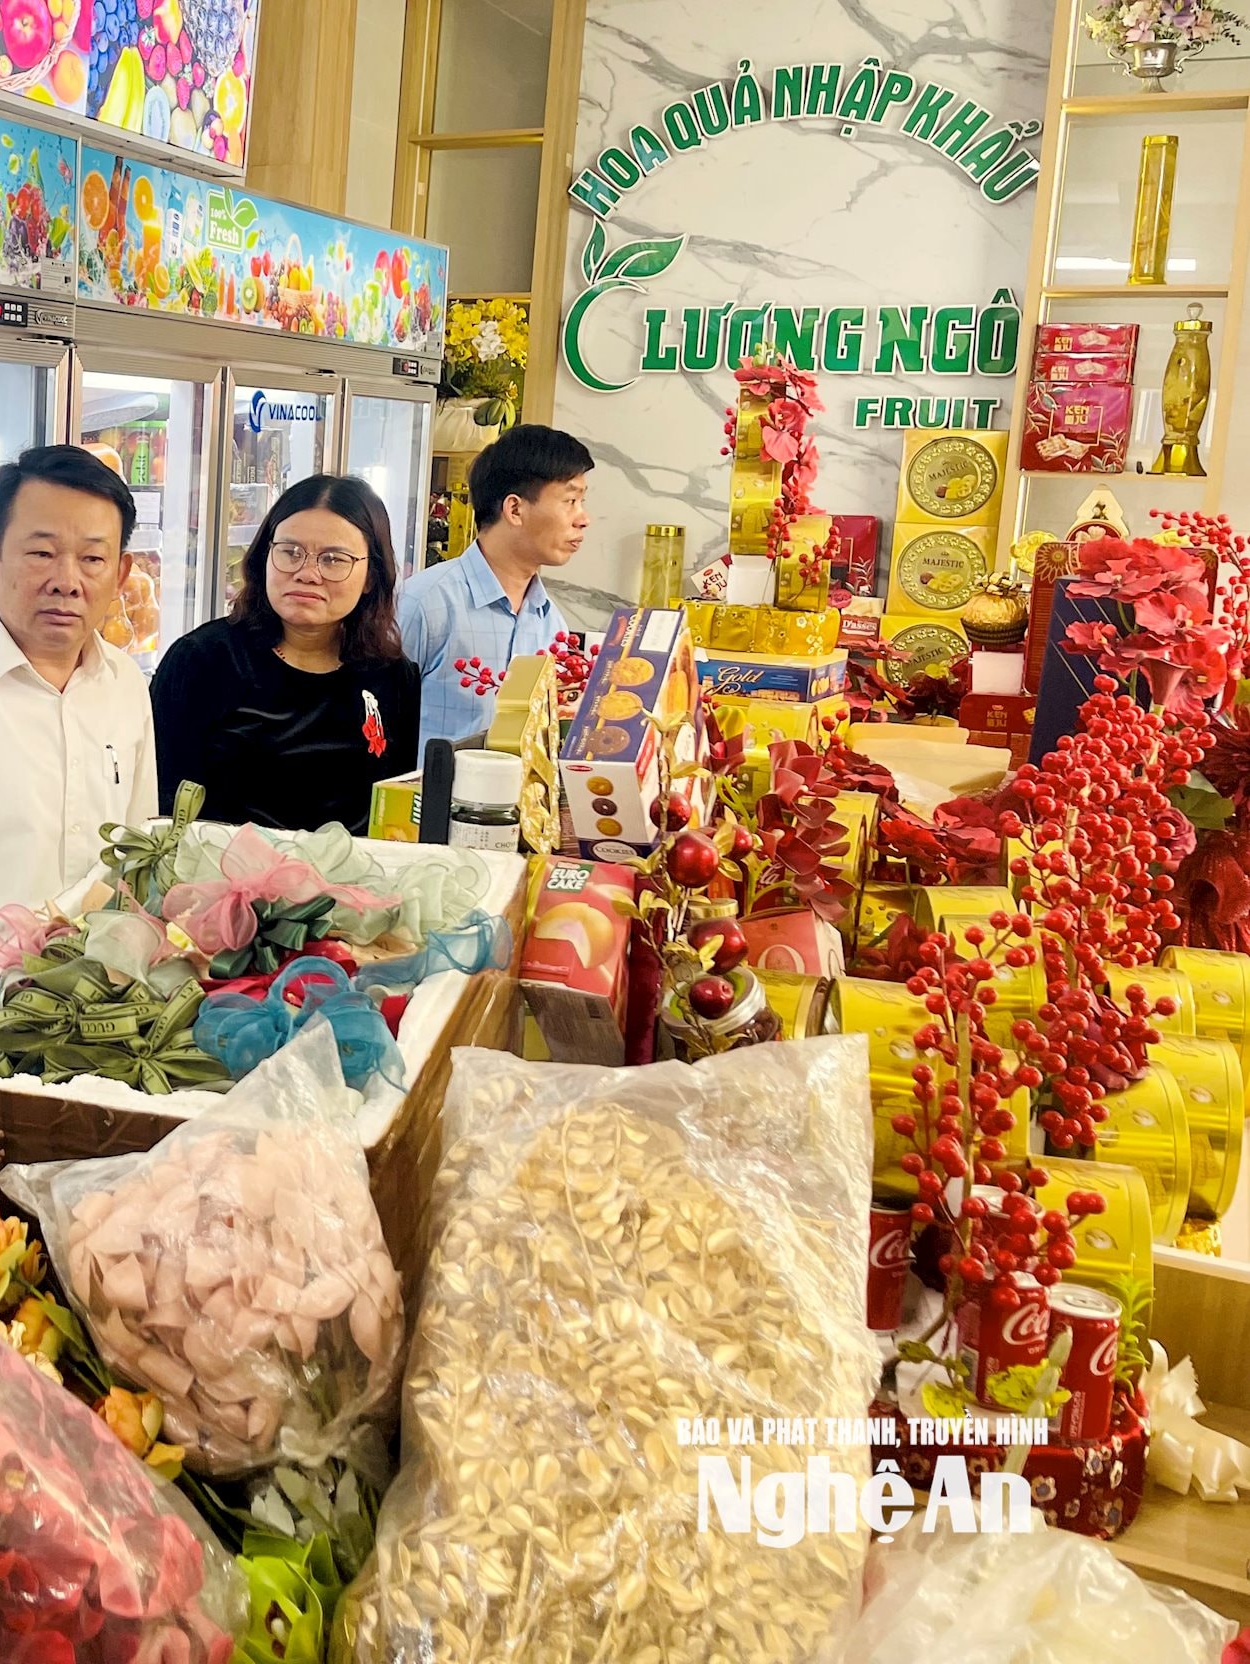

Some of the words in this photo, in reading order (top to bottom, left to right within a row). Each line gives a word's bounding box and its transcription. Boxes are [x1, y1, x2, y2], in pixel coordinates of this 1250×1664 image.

[568, 124, 671, 221] HOA
[662, 57, 765, 153] QUẢ
[770, 55, 916, 139] NHẬP
[900, 80, 1043, 204] KHẨU
[209, 220, 239, 245] Fresh
[639, 301, 868, 375] LƯƠNG
[871, 287, 1023, 376] NGÔ
[1055, 336, 1073, 344] KEN
[1051, 365, 1069, 373] KEN
[268, 403, 323, 421] VINACOOL
[853, 396, 1001, 430] FRUIT
[1065, 405, 1090, 415] KEN
[928, 460, 970, 482] MAJESTIC
[922, 557, 965, 569] MAJESTIC
[702, 571, 723, 586] KEN
[715, 579, 728, 592] JU
[717, 666, 765, 690] Gold
[986, 710, 1008, 719] KEN
[550, 867, 590, 881] EURO
[546, 878, 586, 891] CAKE
